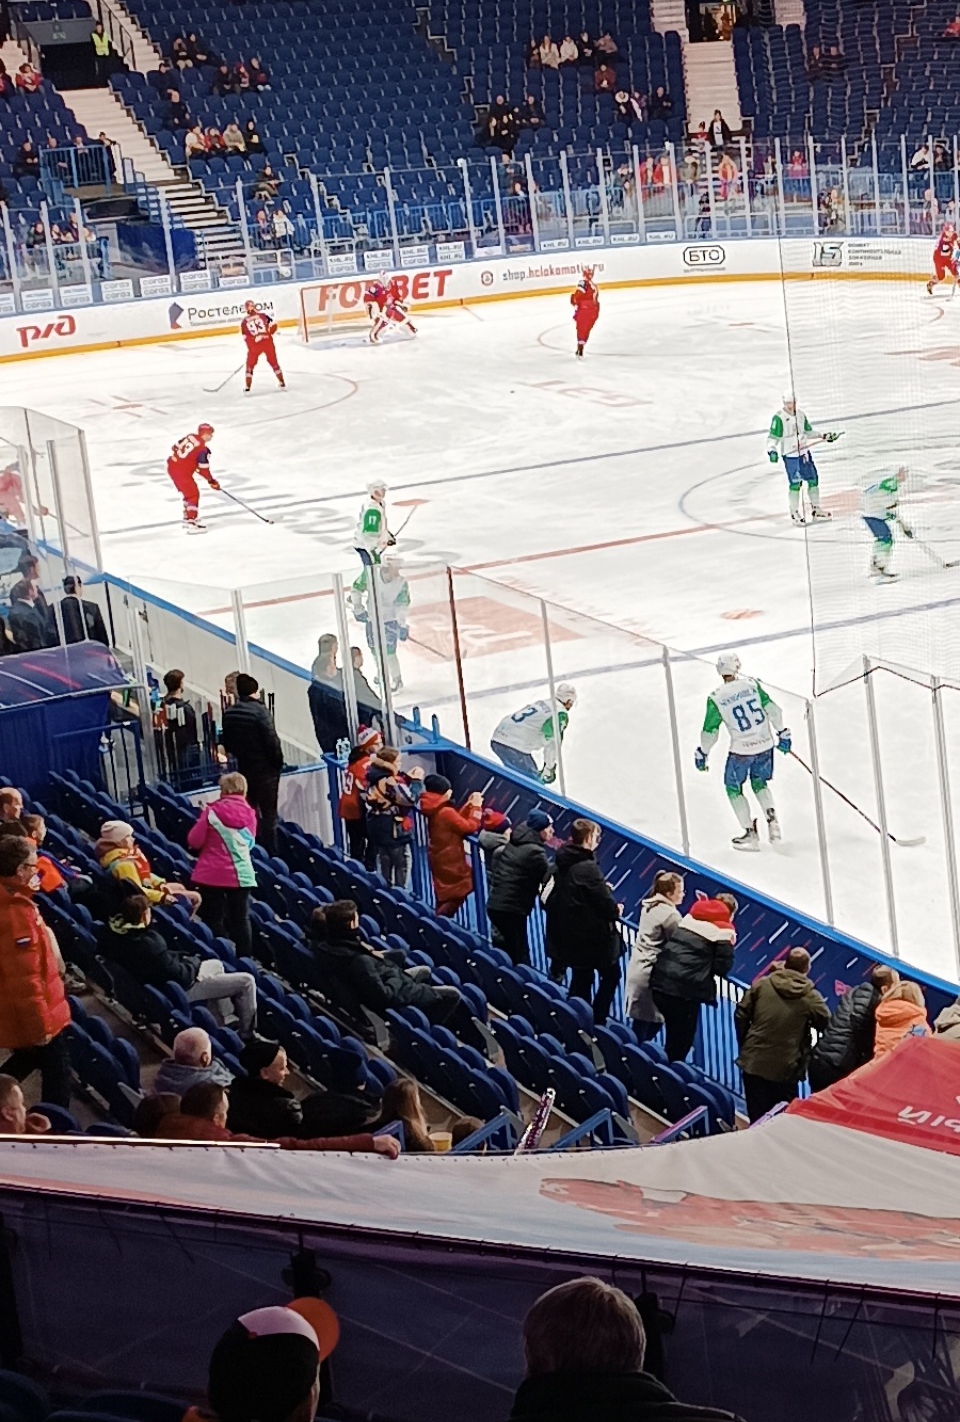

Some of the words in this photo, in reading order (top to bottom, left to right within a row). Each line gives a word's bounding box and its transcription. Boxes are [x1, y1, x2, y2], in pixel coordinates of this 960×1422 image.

[689, 249, 720, 262] БТО
[318, 269, 453, 312] FOBET
[188, 301, 274, 321] Ростелеом
[732, 698, 766, 732] 85
